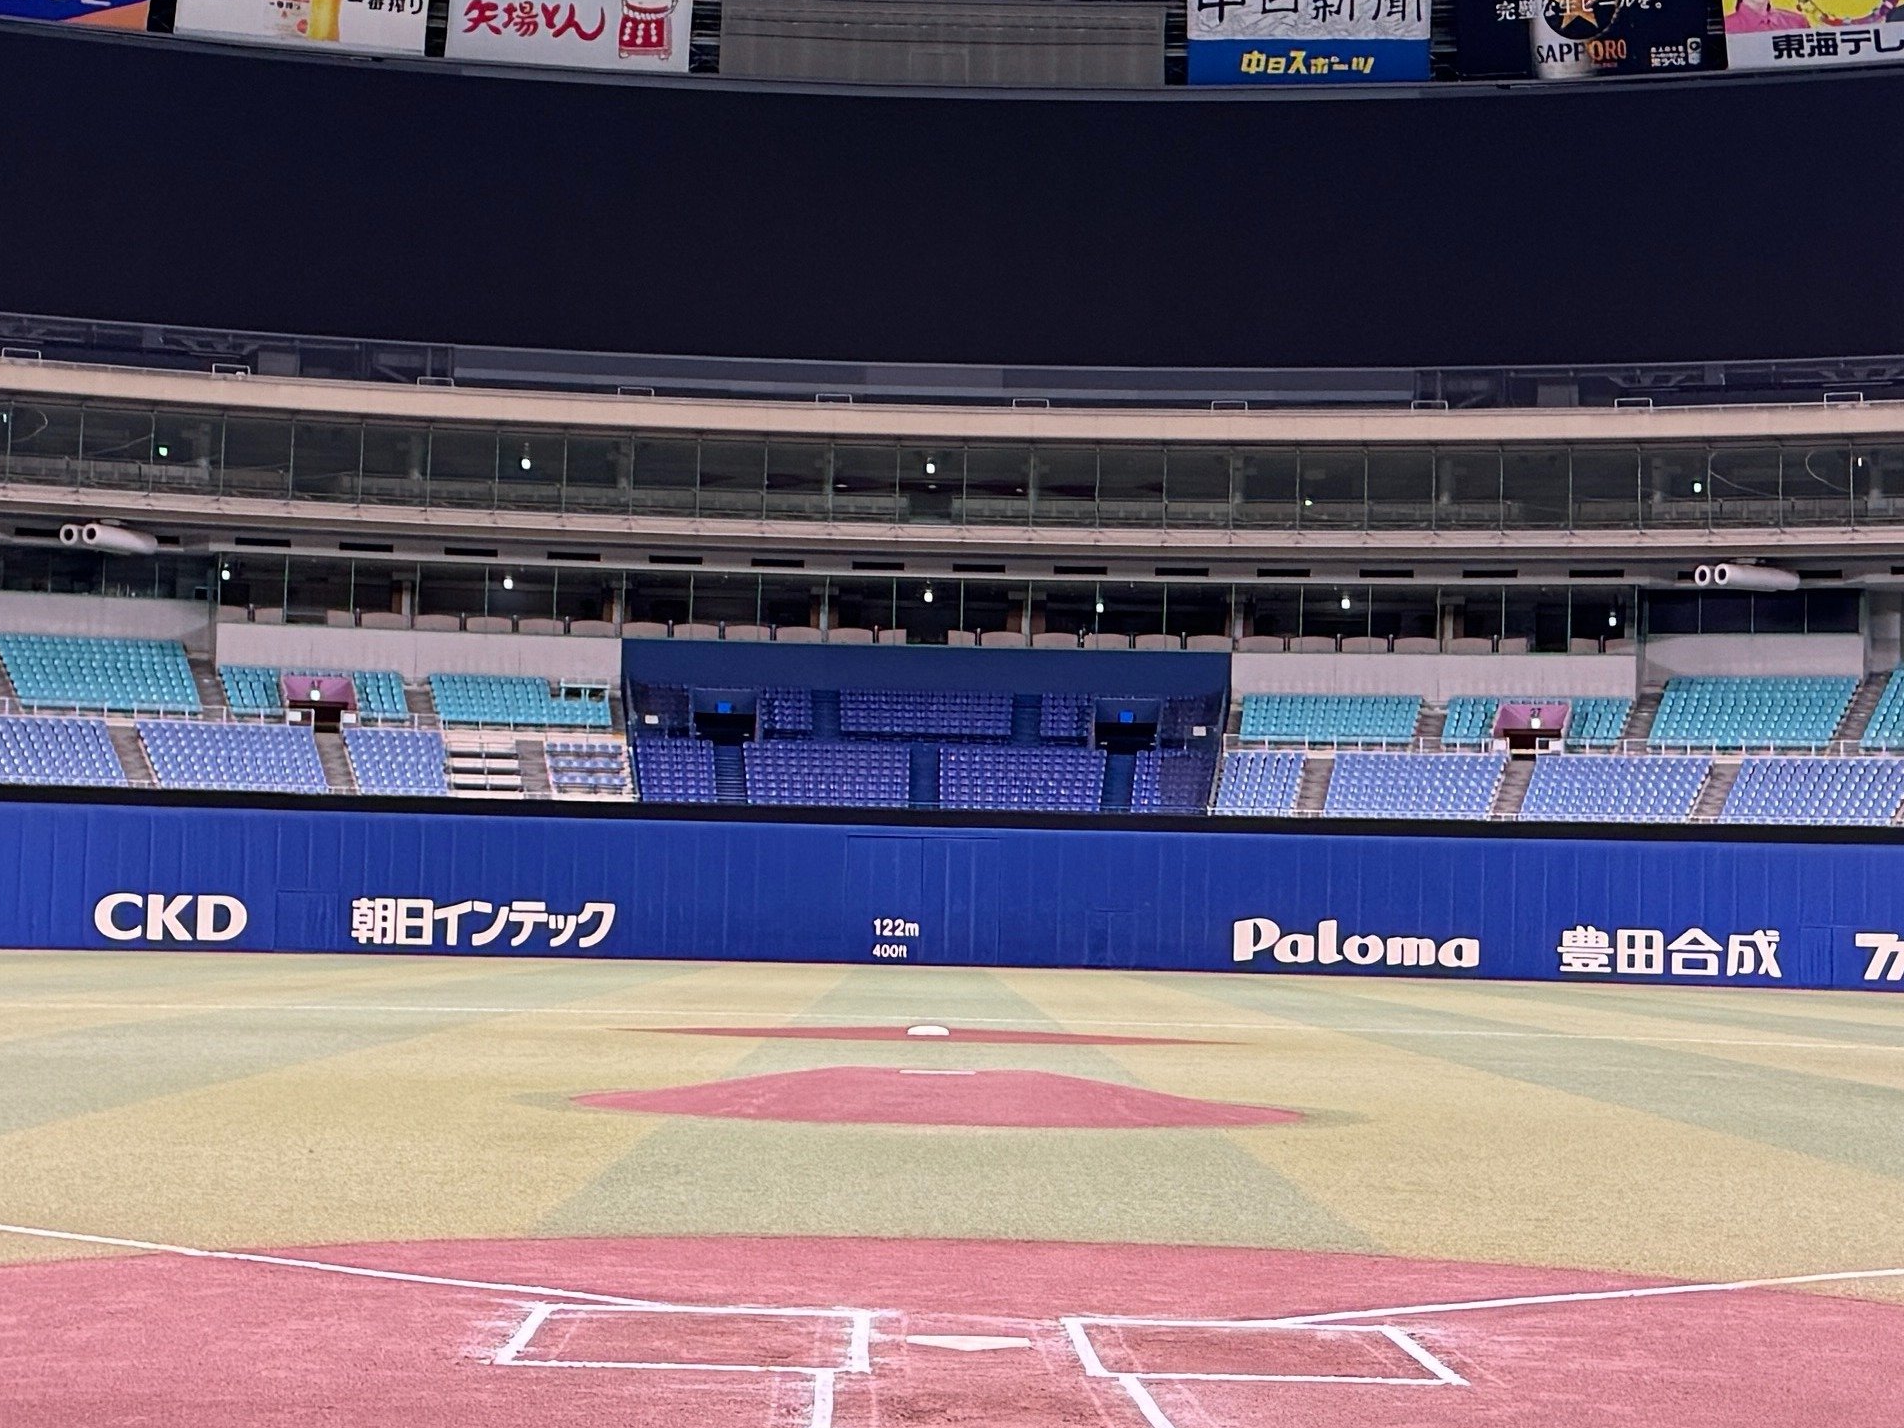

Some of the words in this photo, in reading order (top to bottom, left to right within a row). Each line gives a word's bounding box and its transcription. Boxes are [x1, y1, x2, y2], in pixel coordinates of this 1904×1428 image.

[1240, 50, 1375, 74] 中日スポーツ
[1536, 38, 1627, 64] SAPPORO
[93, 892, 248, 941] CKD
[350, 897, 616, 948] 朝日インテック
[872, 917, 920, 939] 122m
[871, 944, 908, 959] 400ft
[1233, 917, 1480, 968] Paloma
[1557, 924, 1783, 979] 豊田合成
